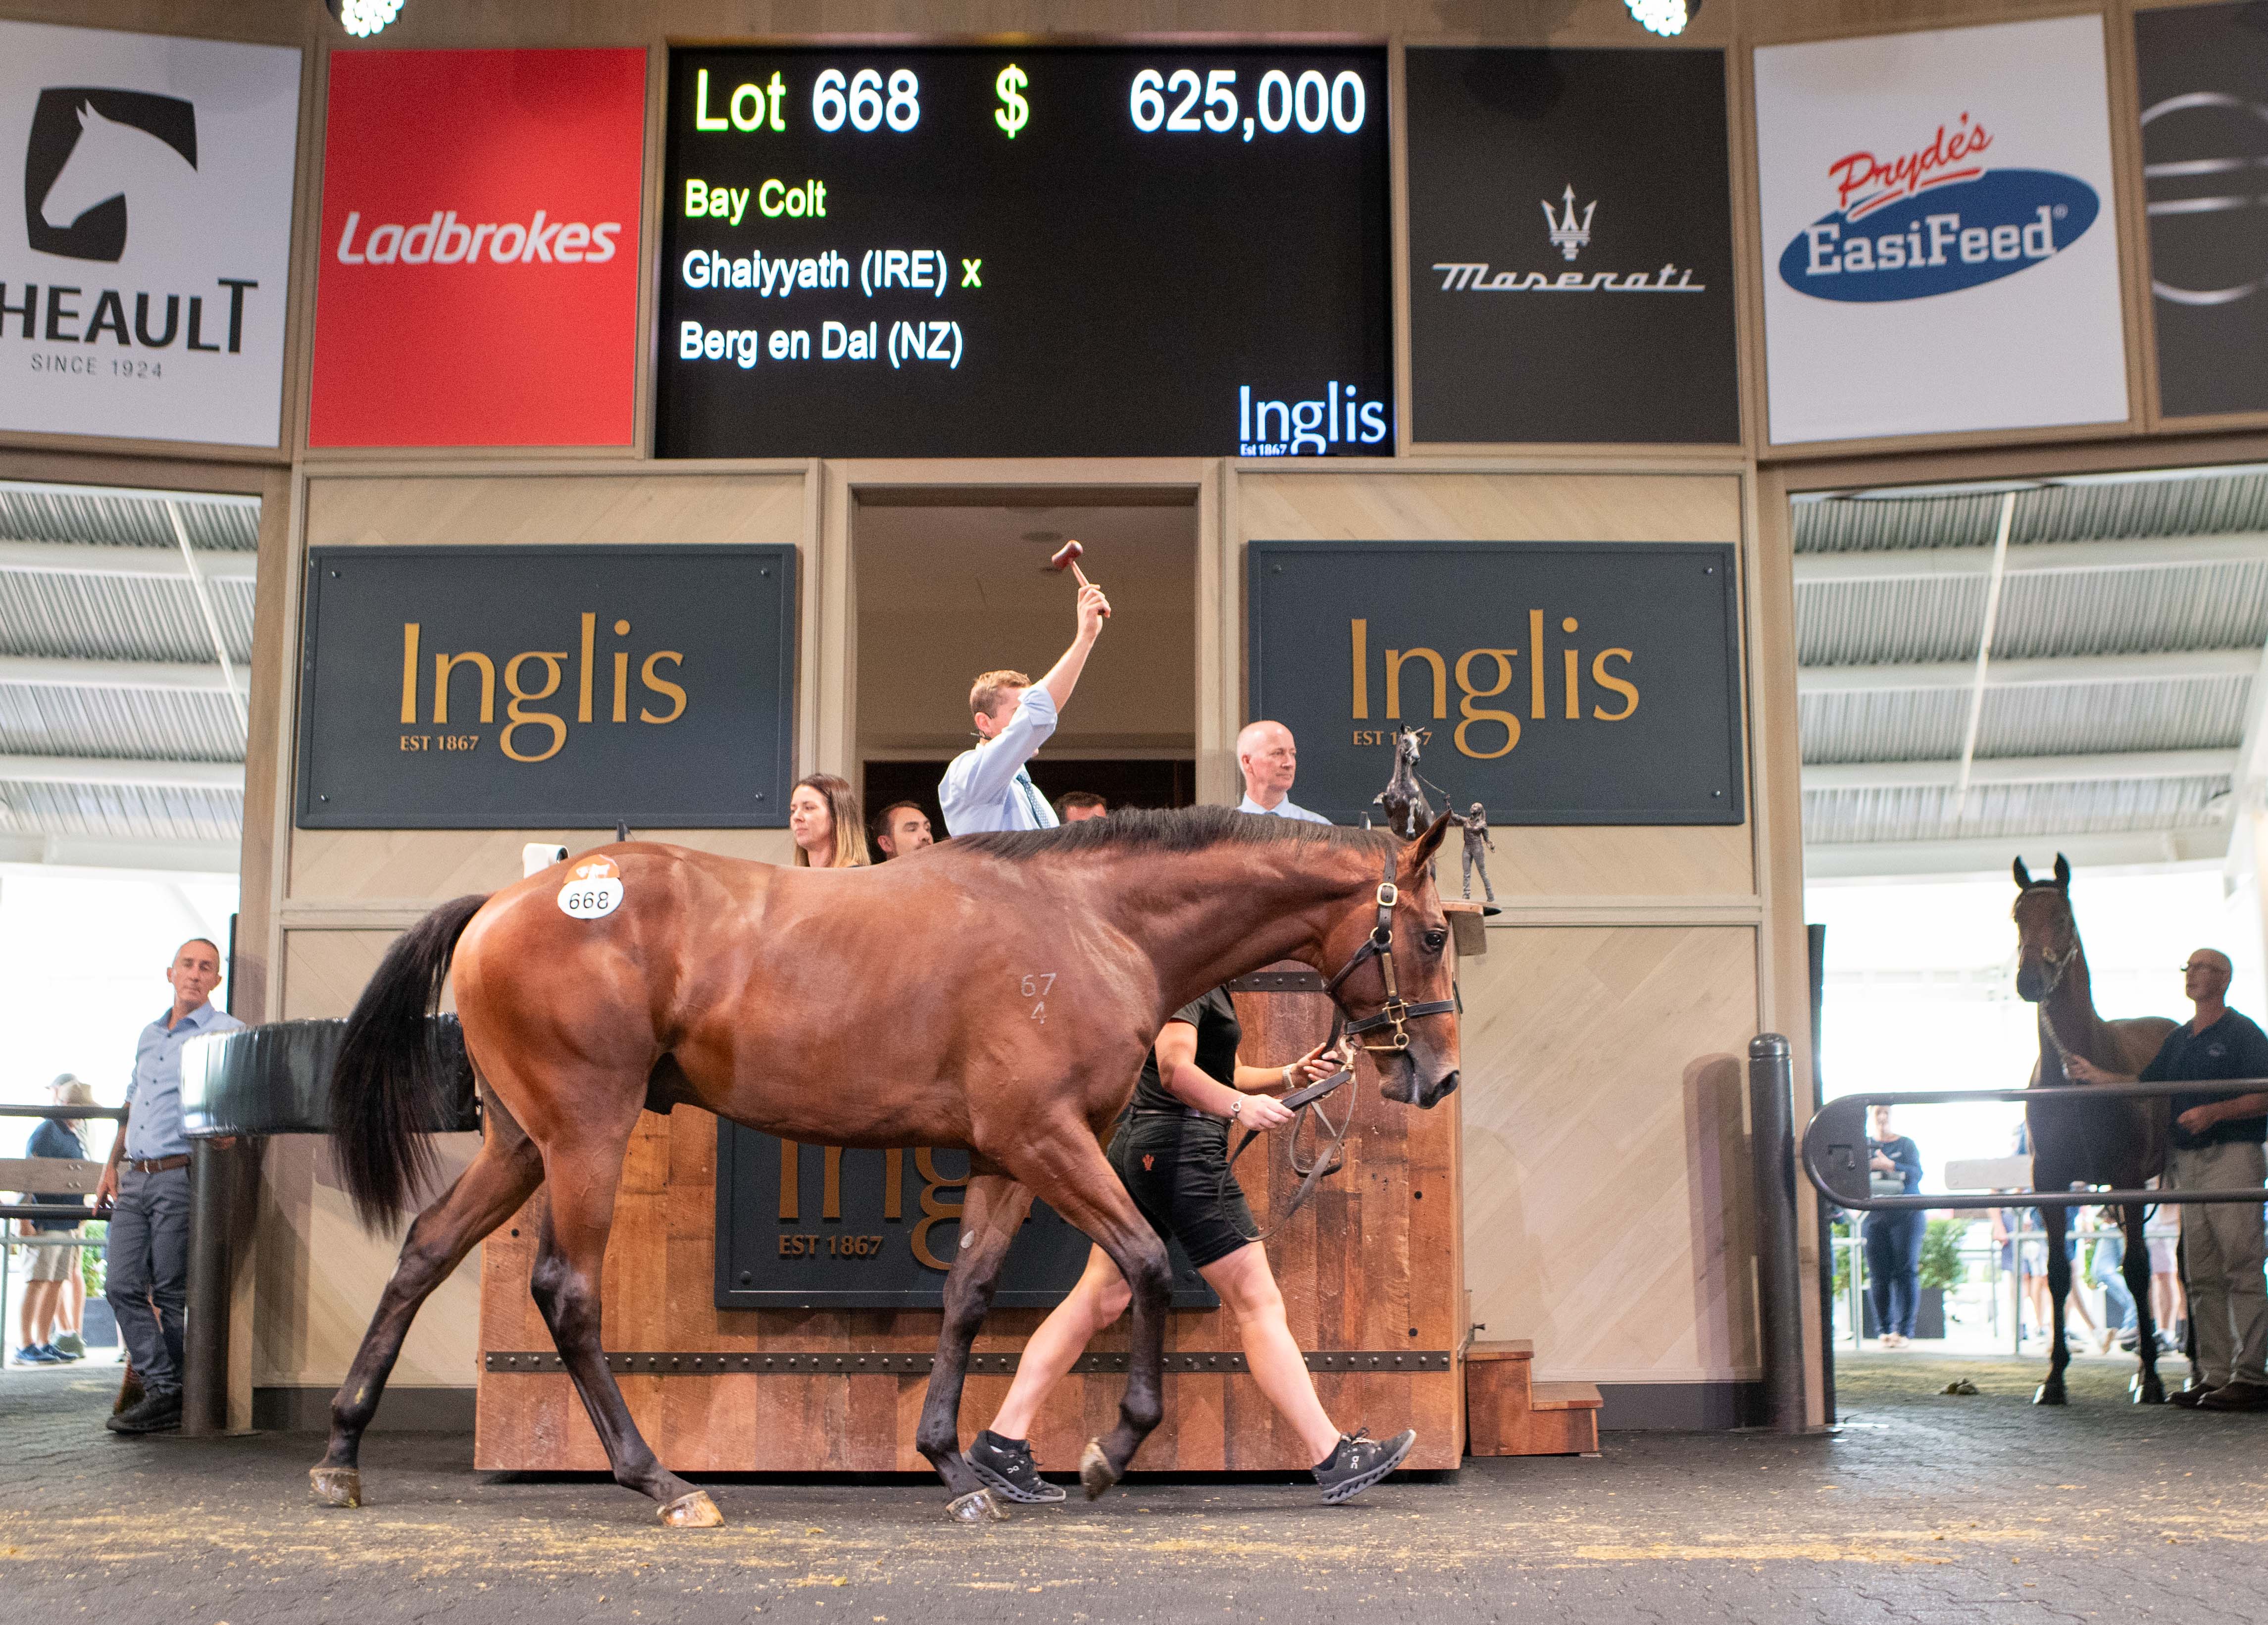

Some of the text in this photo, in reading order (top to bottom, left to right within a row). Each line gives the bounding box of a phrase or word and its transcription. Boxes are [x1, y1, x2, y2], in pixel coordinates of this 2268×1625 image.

[696, 63, 1366, 143] Lot 668 $ 625,000
[1829, 112, 1993, 209] Pryde's
[685, 179, 827, 226] Bay Colt
[337, 210, 621, 265] Ladbrokes
[682, 250, 982, 298] Ghaiyyath (IRE) x
[1432, 262, 1706, 292] Maserati
[0, 278, 259, 354] HEAULT
[31, 354, 162, 378] SINCE 1924
[680, 321, 963, 369] Berg en Dal (NZ)
[1239, 380, 1387, 455] Inglis
[1259, 444, 1287, 457] 1867
[401, 612, 687, 762] Inglis
[1351, 609, 1639, 759] Inglis
[400, 735, 479, 751] EST 1867
[1353, 730, 1432, 746] EST 17
[569, 891, 609, 910] 668
[1021, 972, 1057, 997] 67
[779, 1235, 883, 1255] EST 1867
